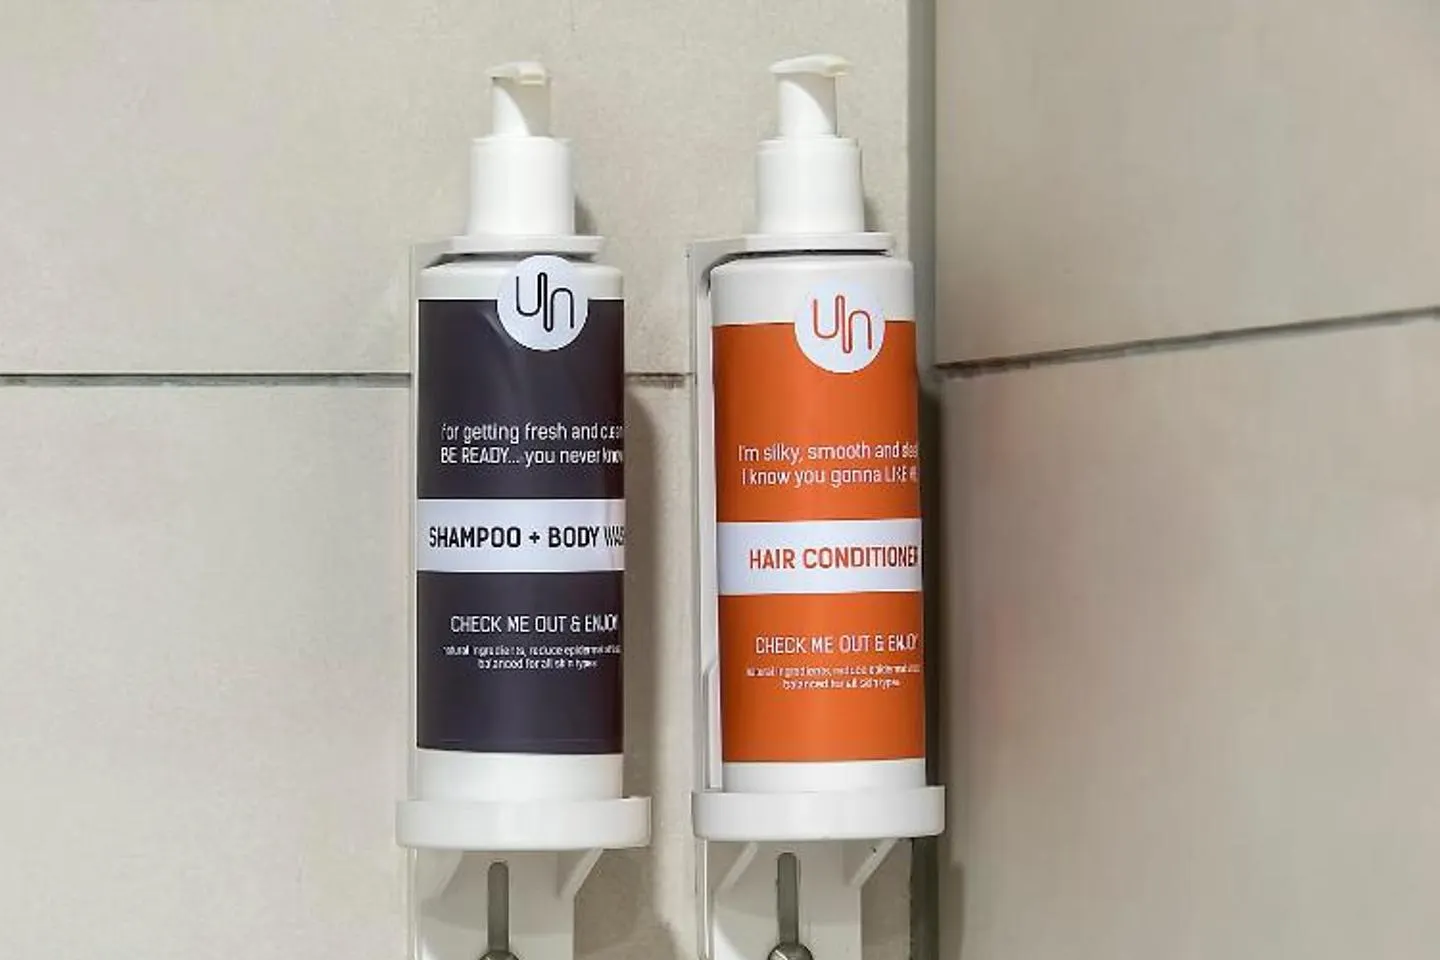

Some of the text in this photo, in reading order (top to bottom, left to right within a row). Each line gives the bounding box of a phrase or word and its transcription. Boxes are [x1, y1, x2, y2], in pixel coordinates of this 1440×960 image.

[464, 423, 519, 444] getting
[525, 422, 567, 440] fresh
[571, 422, 598, 440] and
[441, 447, 457, 463] BE
[462, 447, 520, 463] READY...
[525, 449, 555, 467] you
[560, 449, 600, 463] never
[738, 445, 760, 461] I'm
[763, 443, 803, 465] silky,
[808, 443, 871, 460] smooth
[875, 440, 900, 459] and
[750, 468, 790, 485] know
[794, 470, 825, 488] you
[831, 469, 881, 488] gonna
[429, 526, 521, 548] SHAMPOO
[529, 531, 540, 543] +
[548, 526, 599, 547] BODY
[750, 548, 795, 569] HAIR
[450, 614, 619, 632] CHECK ME OUT & ENJOY
[756, 636, 807, 654] CHECK
[811, 635, 834, 653] ME
[839, 635, 870, 652] OUT
